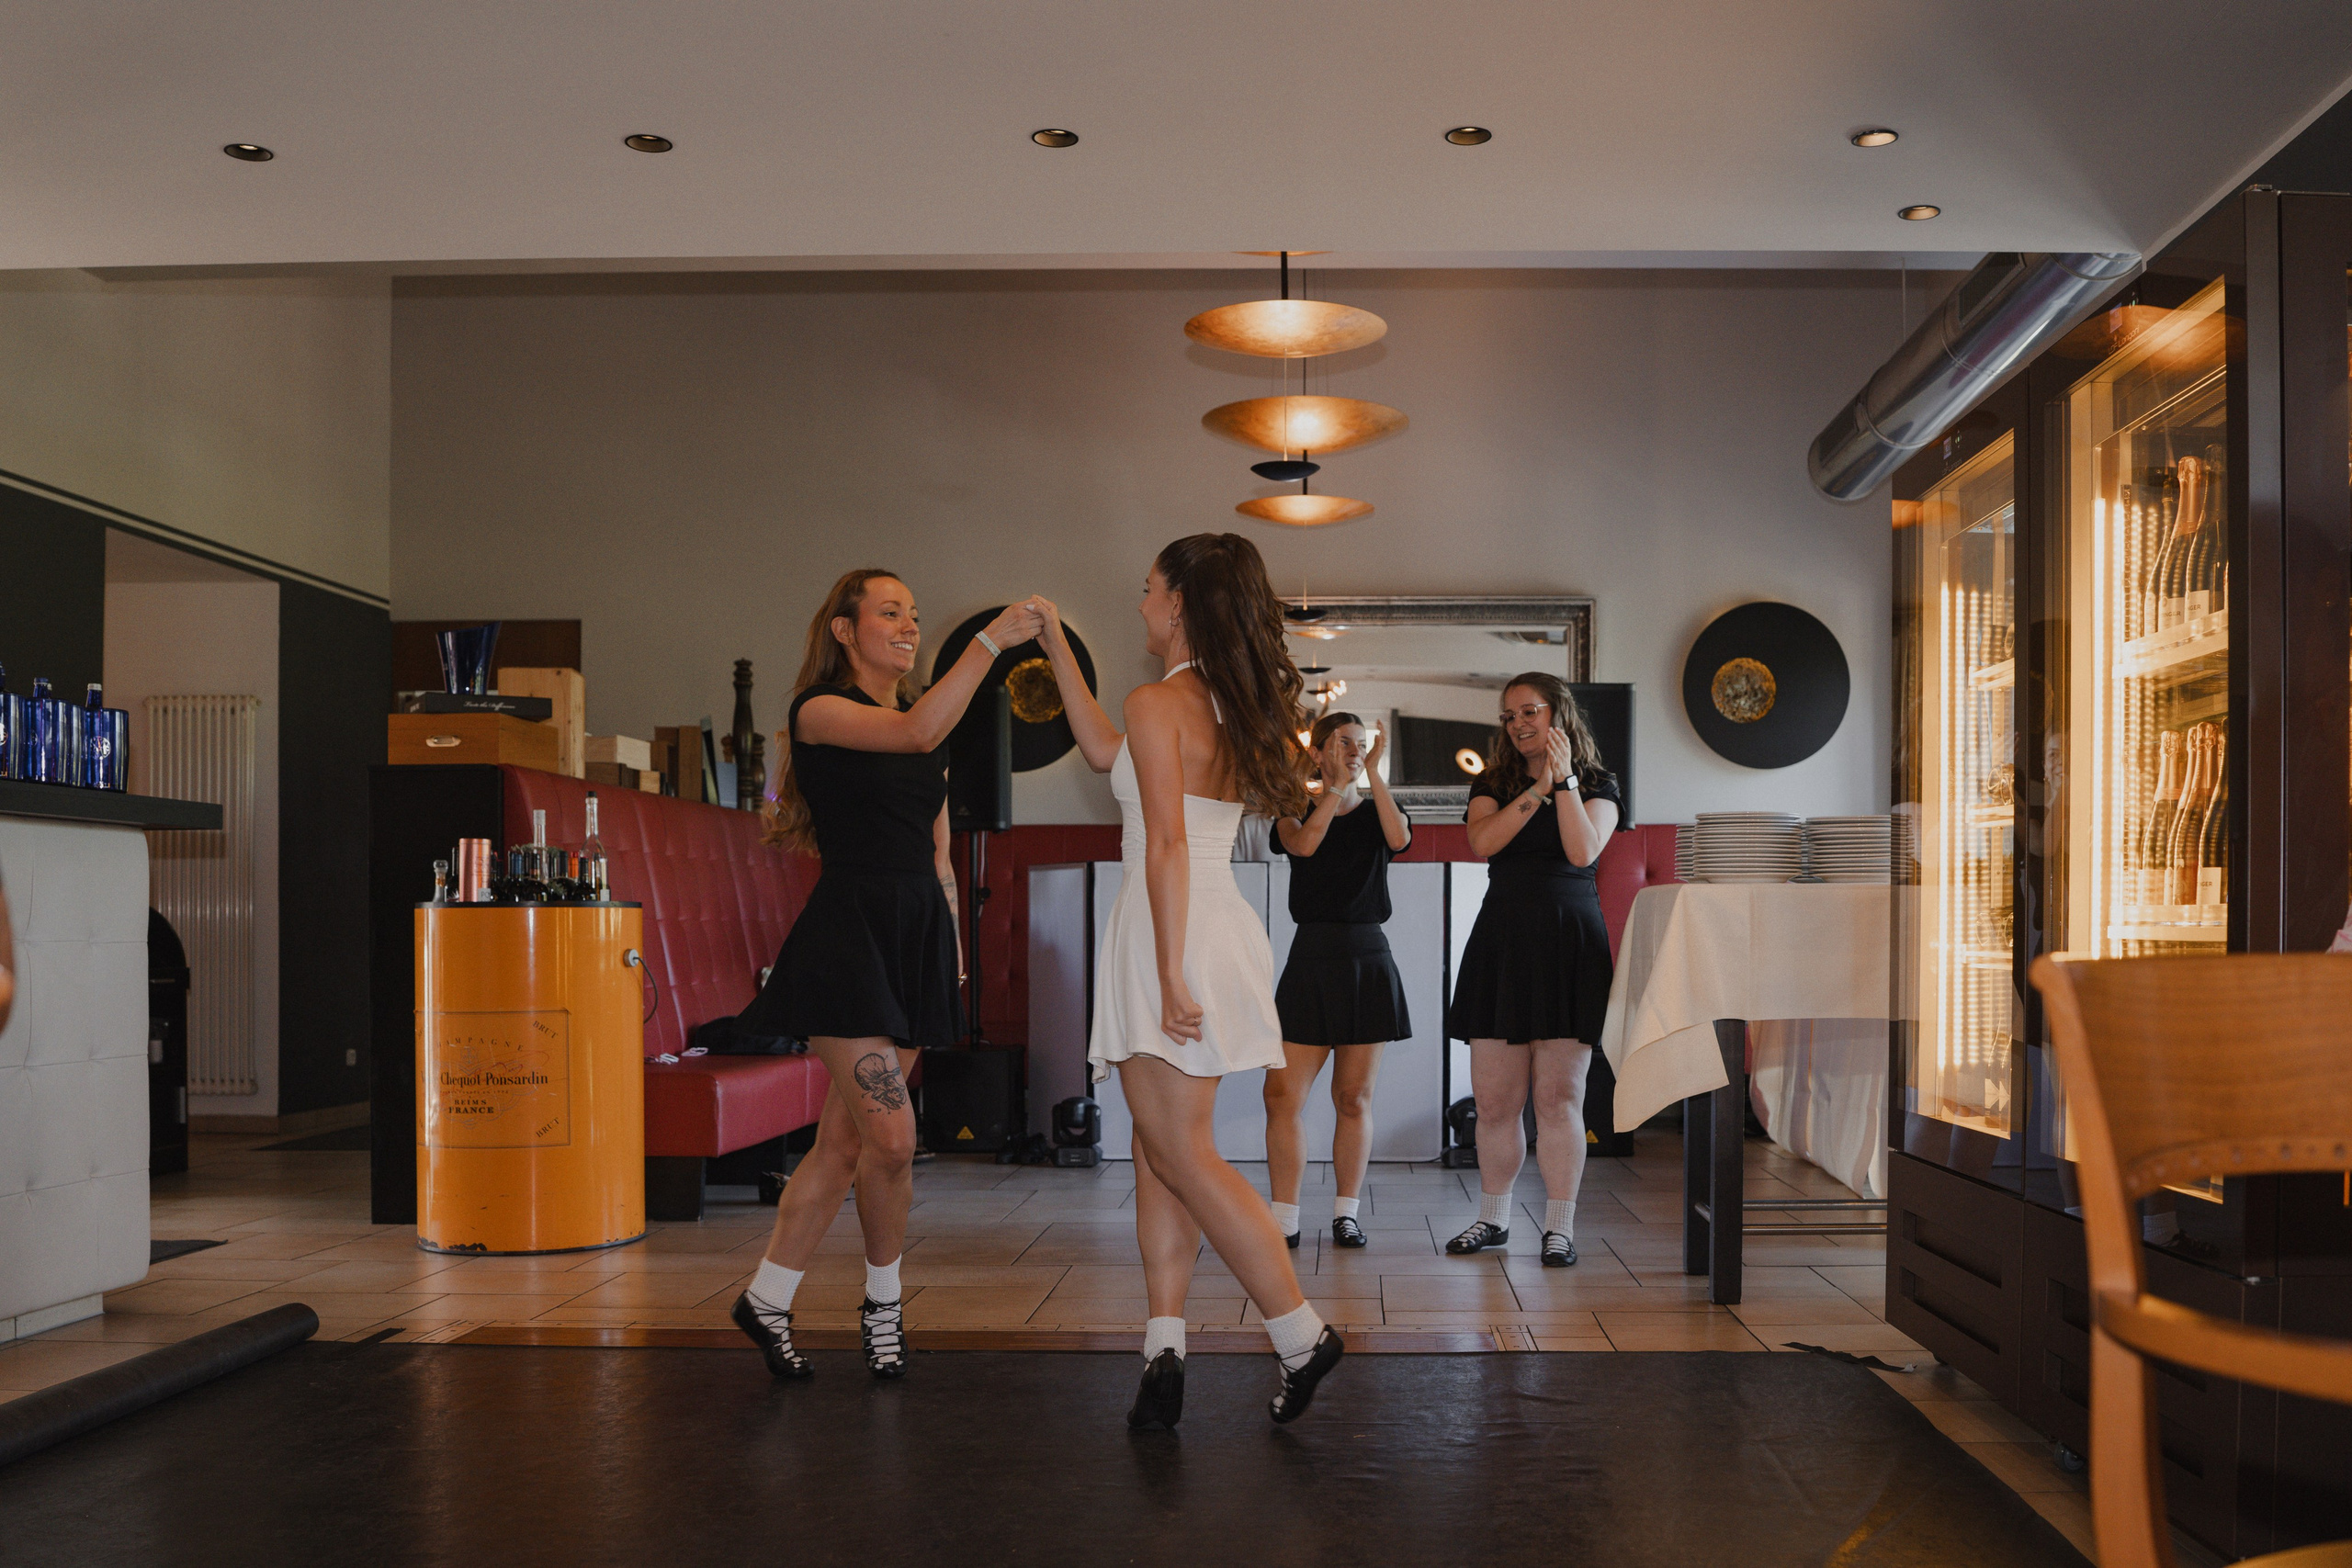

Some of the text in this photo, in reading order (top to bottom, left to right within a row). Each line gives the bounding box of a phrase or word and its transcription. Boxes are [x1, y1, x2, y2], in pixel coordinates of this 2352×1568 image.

[533, 1020, 559, 1039] BRUT
[485, 1071, 548, 1085] Ponsardin
[448, 1106, 494, 1114] FRANCE
[536, 1117, 560, 1138] BRUT
